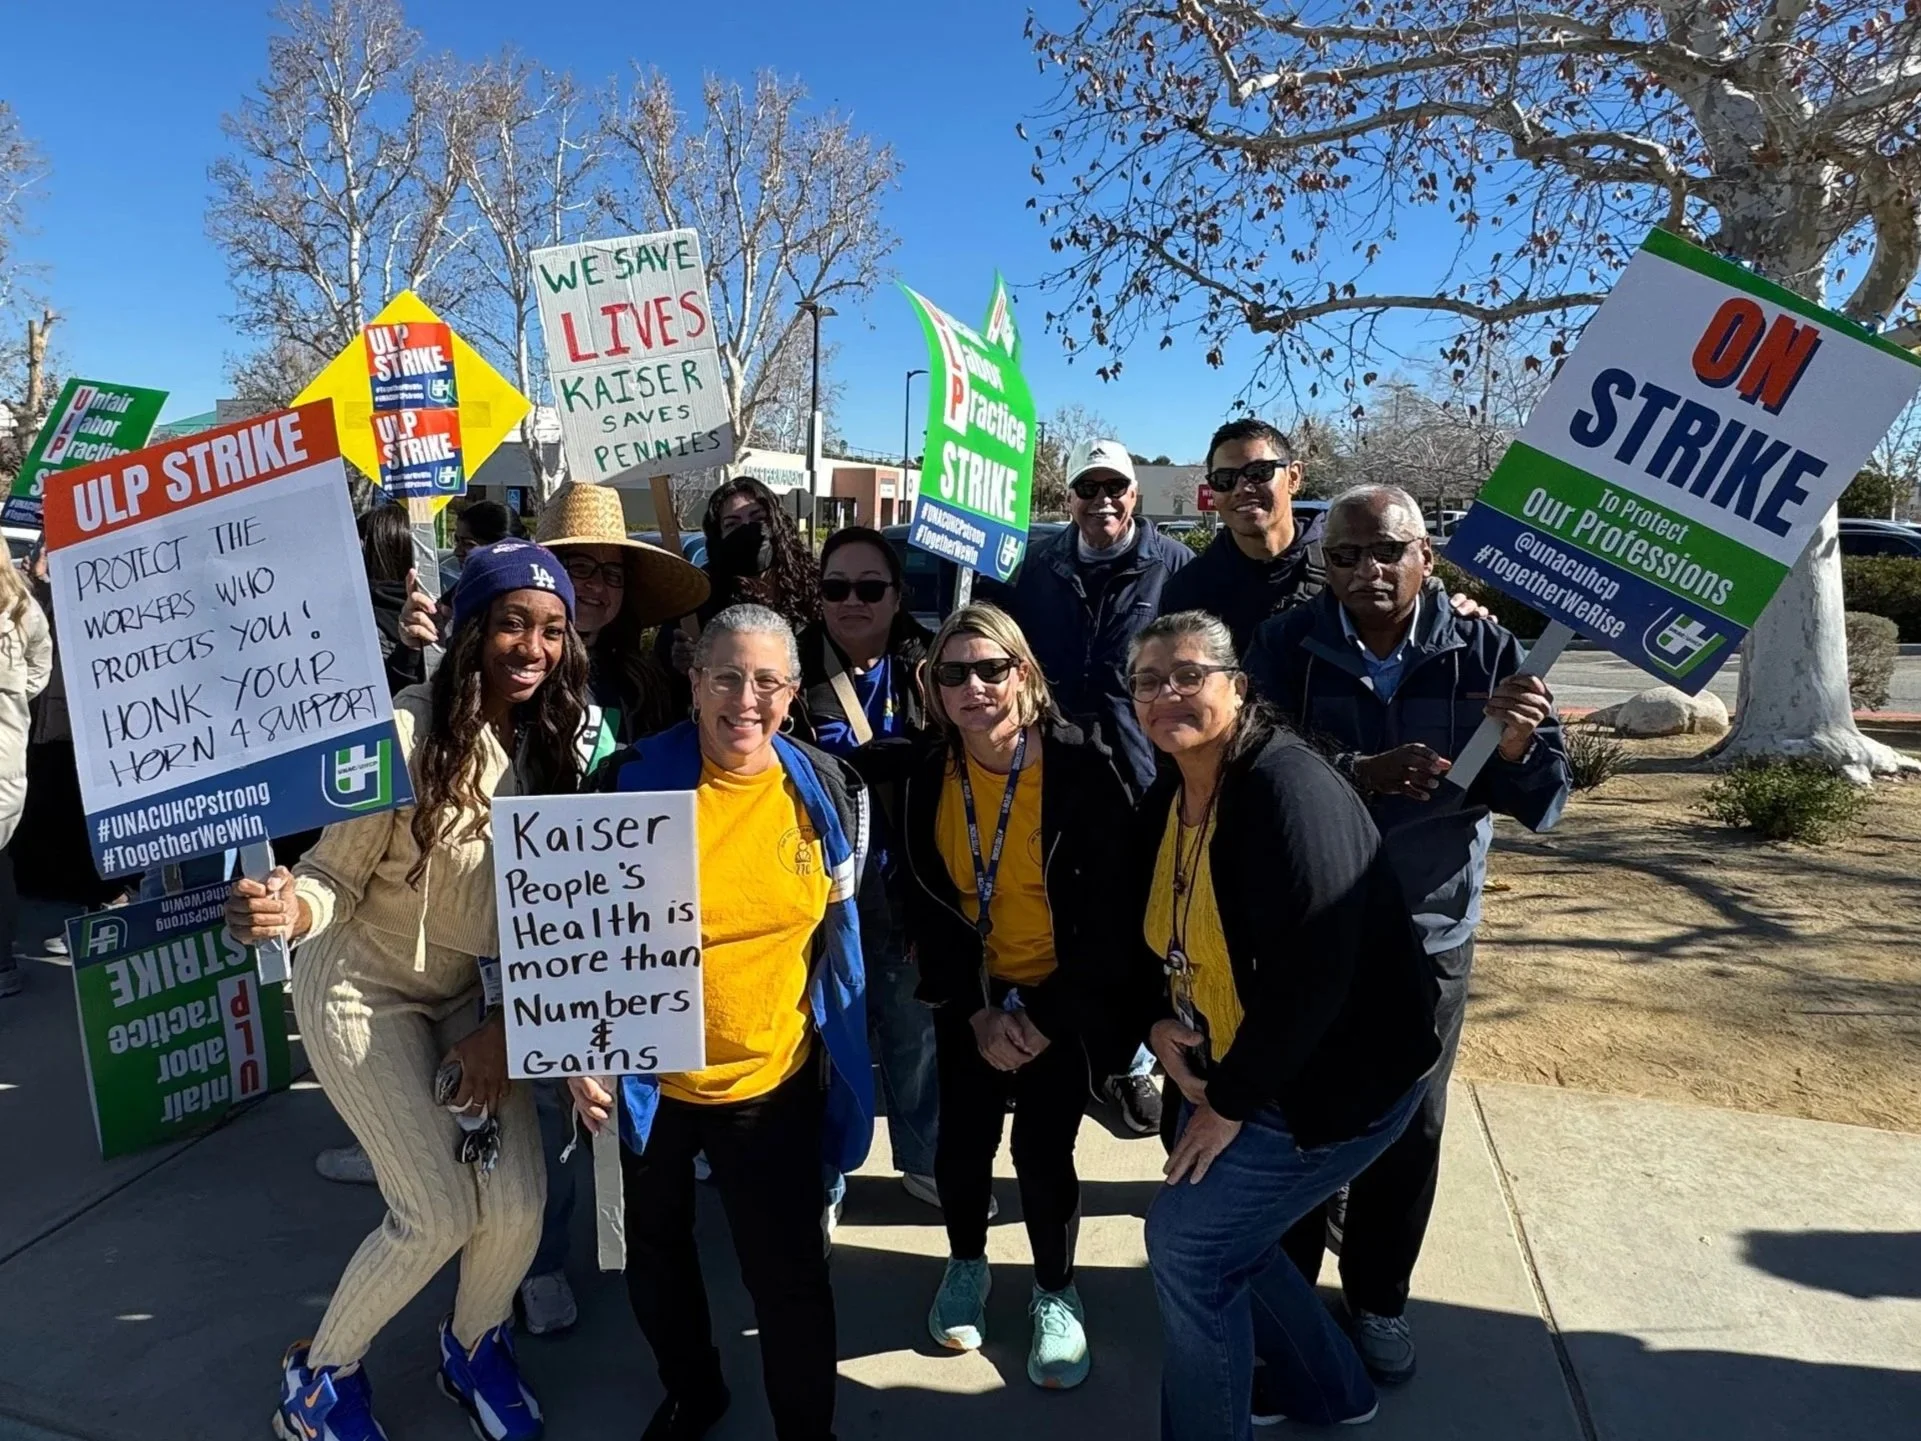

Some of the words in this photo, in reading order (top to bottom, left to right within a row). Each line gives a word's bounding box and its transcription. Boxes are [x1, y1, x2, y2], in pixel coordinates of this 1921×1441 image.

[539, 255, 604, 294] WE
[613, 240, 696, 280] SAVE
[367, 324, 409, 356] ULP
[561, 290, 706, 363] LIVES
[1691, 296, 1823, 416] ON
[374, 346, 448, 382] STRIKE
[560, 359, 703, 413] KAISER
[375, 411, 418, 444] ULP
[602, 405, 690, 433] SAVES
[73, 464, 150, 532] ULP
[162, 411, 308, 503] STRIKE
[383, 432, 456, 470] STRIKE
[594, 431, 721, 472] PENNIES
[1569, 367, 1829, 539] STRIKE
[940, 441, 1019, 523] STRIKE
[1597, 488, 1621, 510] To
[1622, 497, 1690, 544] Protect
[75, 535, 189, 601] PROTECT
[208, 516, 268, 555] THE
[530, 563, 556, 590] LA
[1514, 530, 1621, 601] @unacuhcp
[1521, 487, 1574, 531] Our
[1576, 507, 1735, 607] Professions
[84, 590, 196, 639] WORKERS
[215, 566, 274, 607] WHO
[1472, 544, 1627, 640] #TogetherWeRise
[92, 630, 214, 689] PROTECTS
[103, 684, 213, 749] HONK
[221, 650, 345, 711] YOUR
[110, 726, 214, 786] HORN
[230, 721, 249, 748] 4
[259, 685, 378, 742] SUPPORT
[98, 781, 271, 842] #UNACUHCPstrong
[513, 811, 672, 860] Kaiser
[103, 812, 264, 873] #TogetherWeWin
[161, 883, 232, 915] etherWeWin
[505, 861, 647, 909] People's
[155, 903, 226, 933] UHCPstrong
[513, 901, 650, 950] Health
[667, 900, 695, 924] is
[105, 926, 248, 1008] STRIKE
[508, 949, 609, 983] more
[621, 943, 702, 971] than
[108, 978, 252, 1055] Practice
[513, 989, 691, 1027] Numbers
[156, 1020, 253, 1084] Labor
[522, 1046, 659, 1076] Gains
[160, 1058, 260, 1124] Unfair
